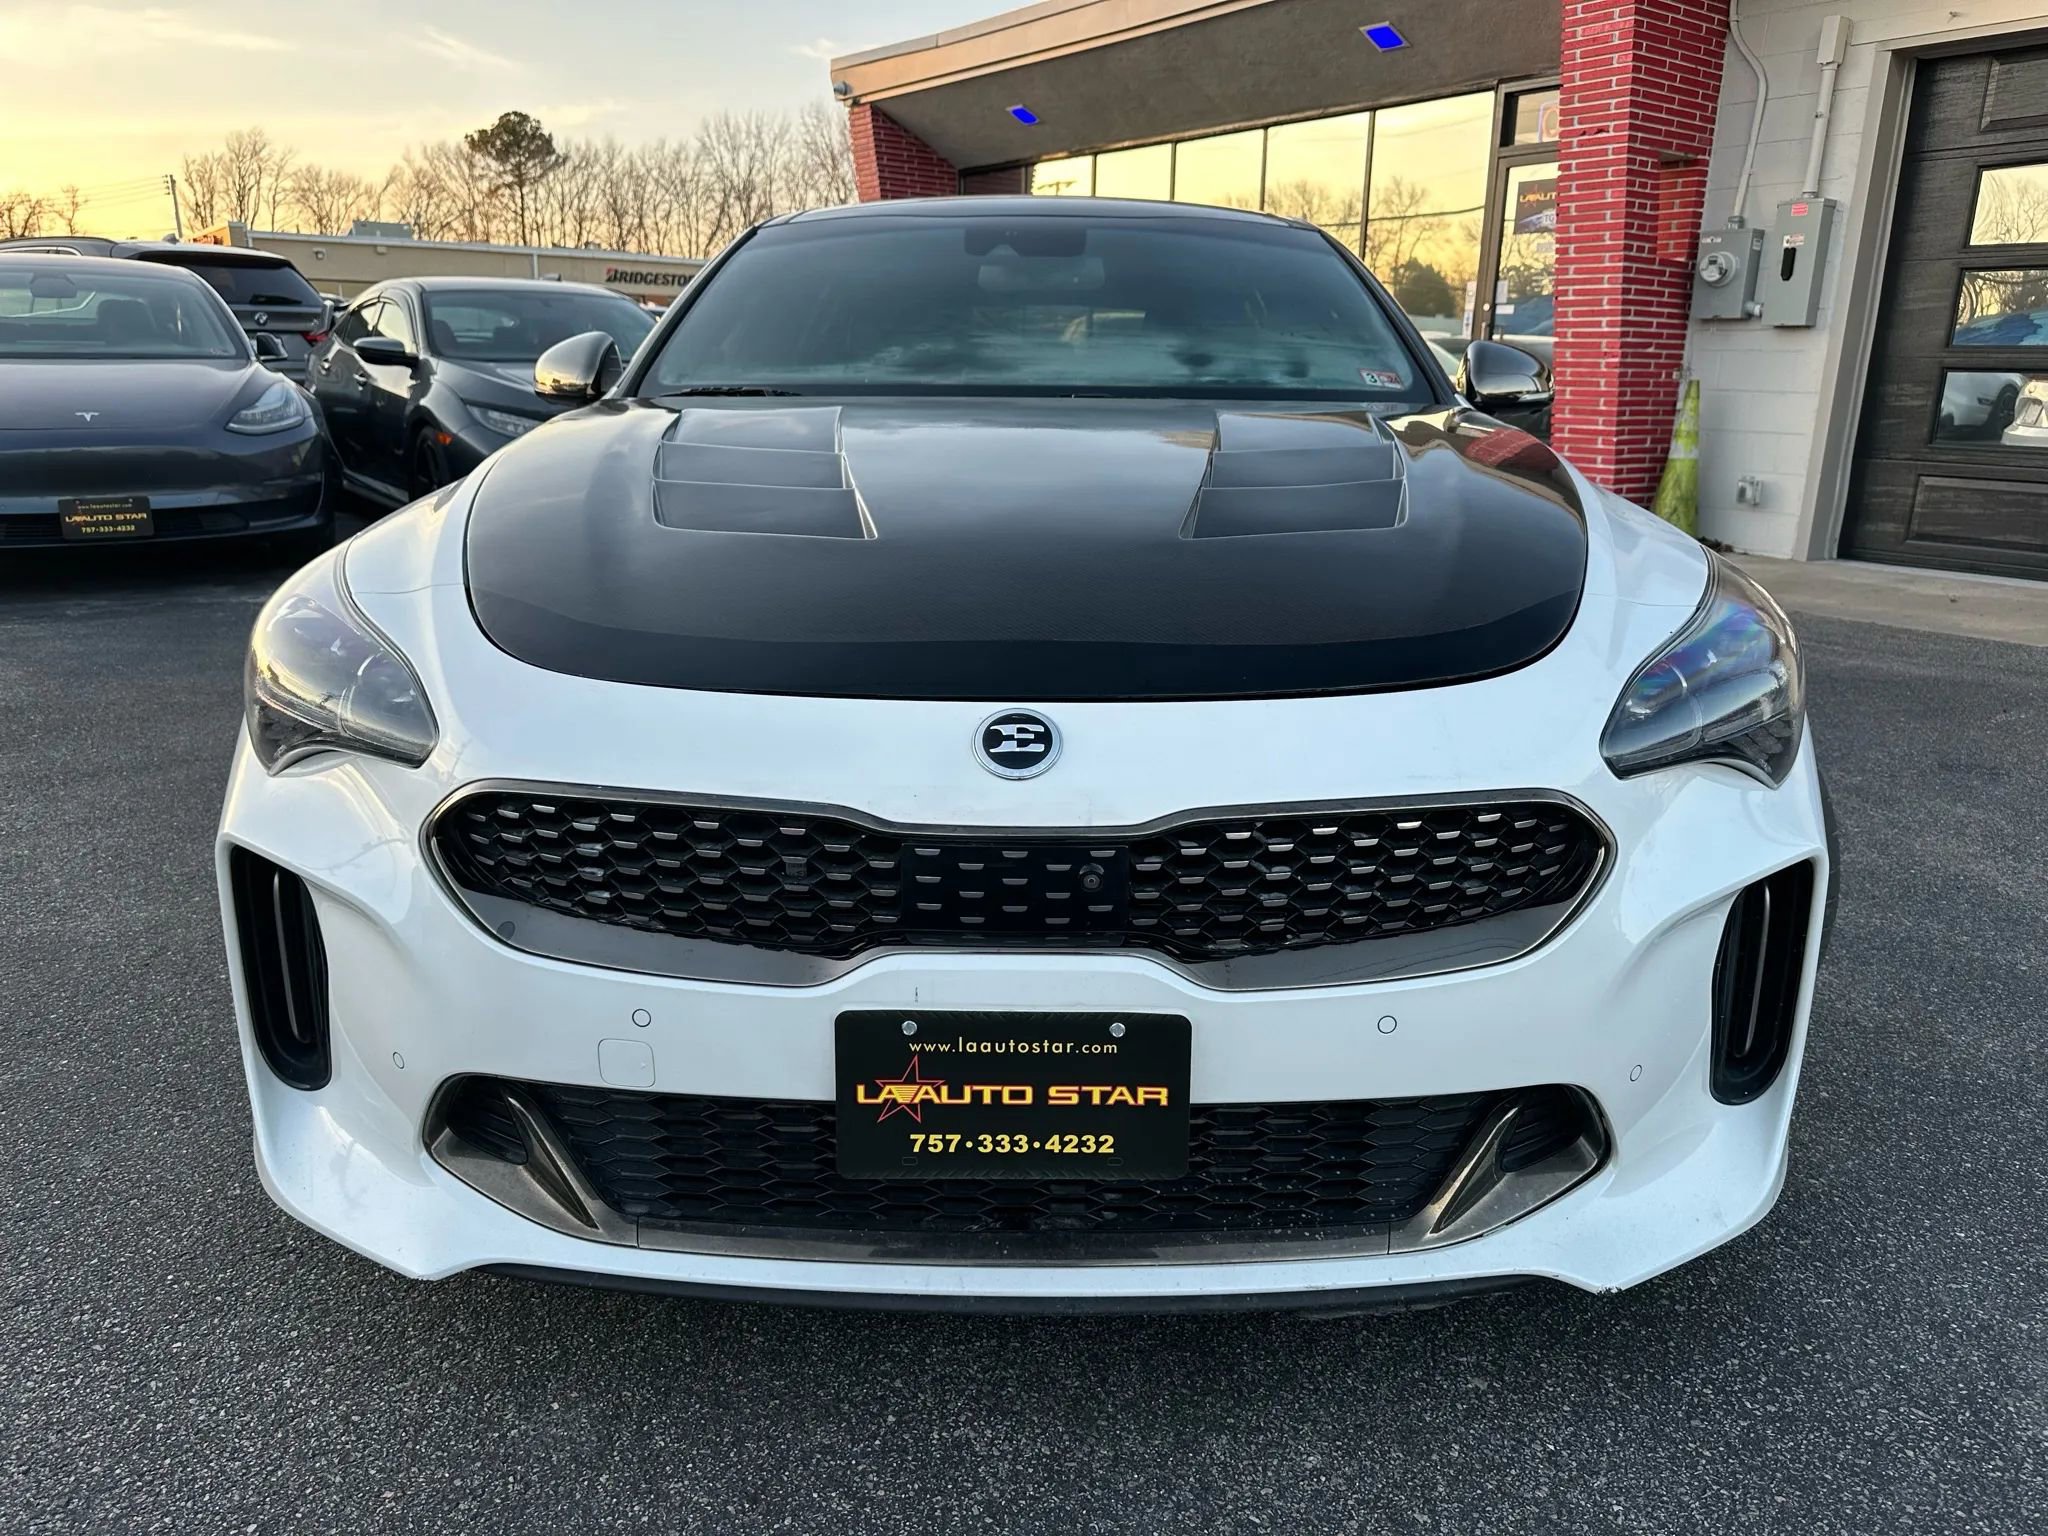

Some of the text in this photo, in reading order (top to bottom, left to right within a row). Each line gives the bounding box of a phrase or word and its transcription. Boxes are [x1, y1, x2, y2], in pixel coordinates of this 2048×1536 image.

[115, 512, 147, 521] STAR
[908, 1036, 1119, 1055] www.laautostar.com
[1047, 1085, 1169, 1107] STAR
